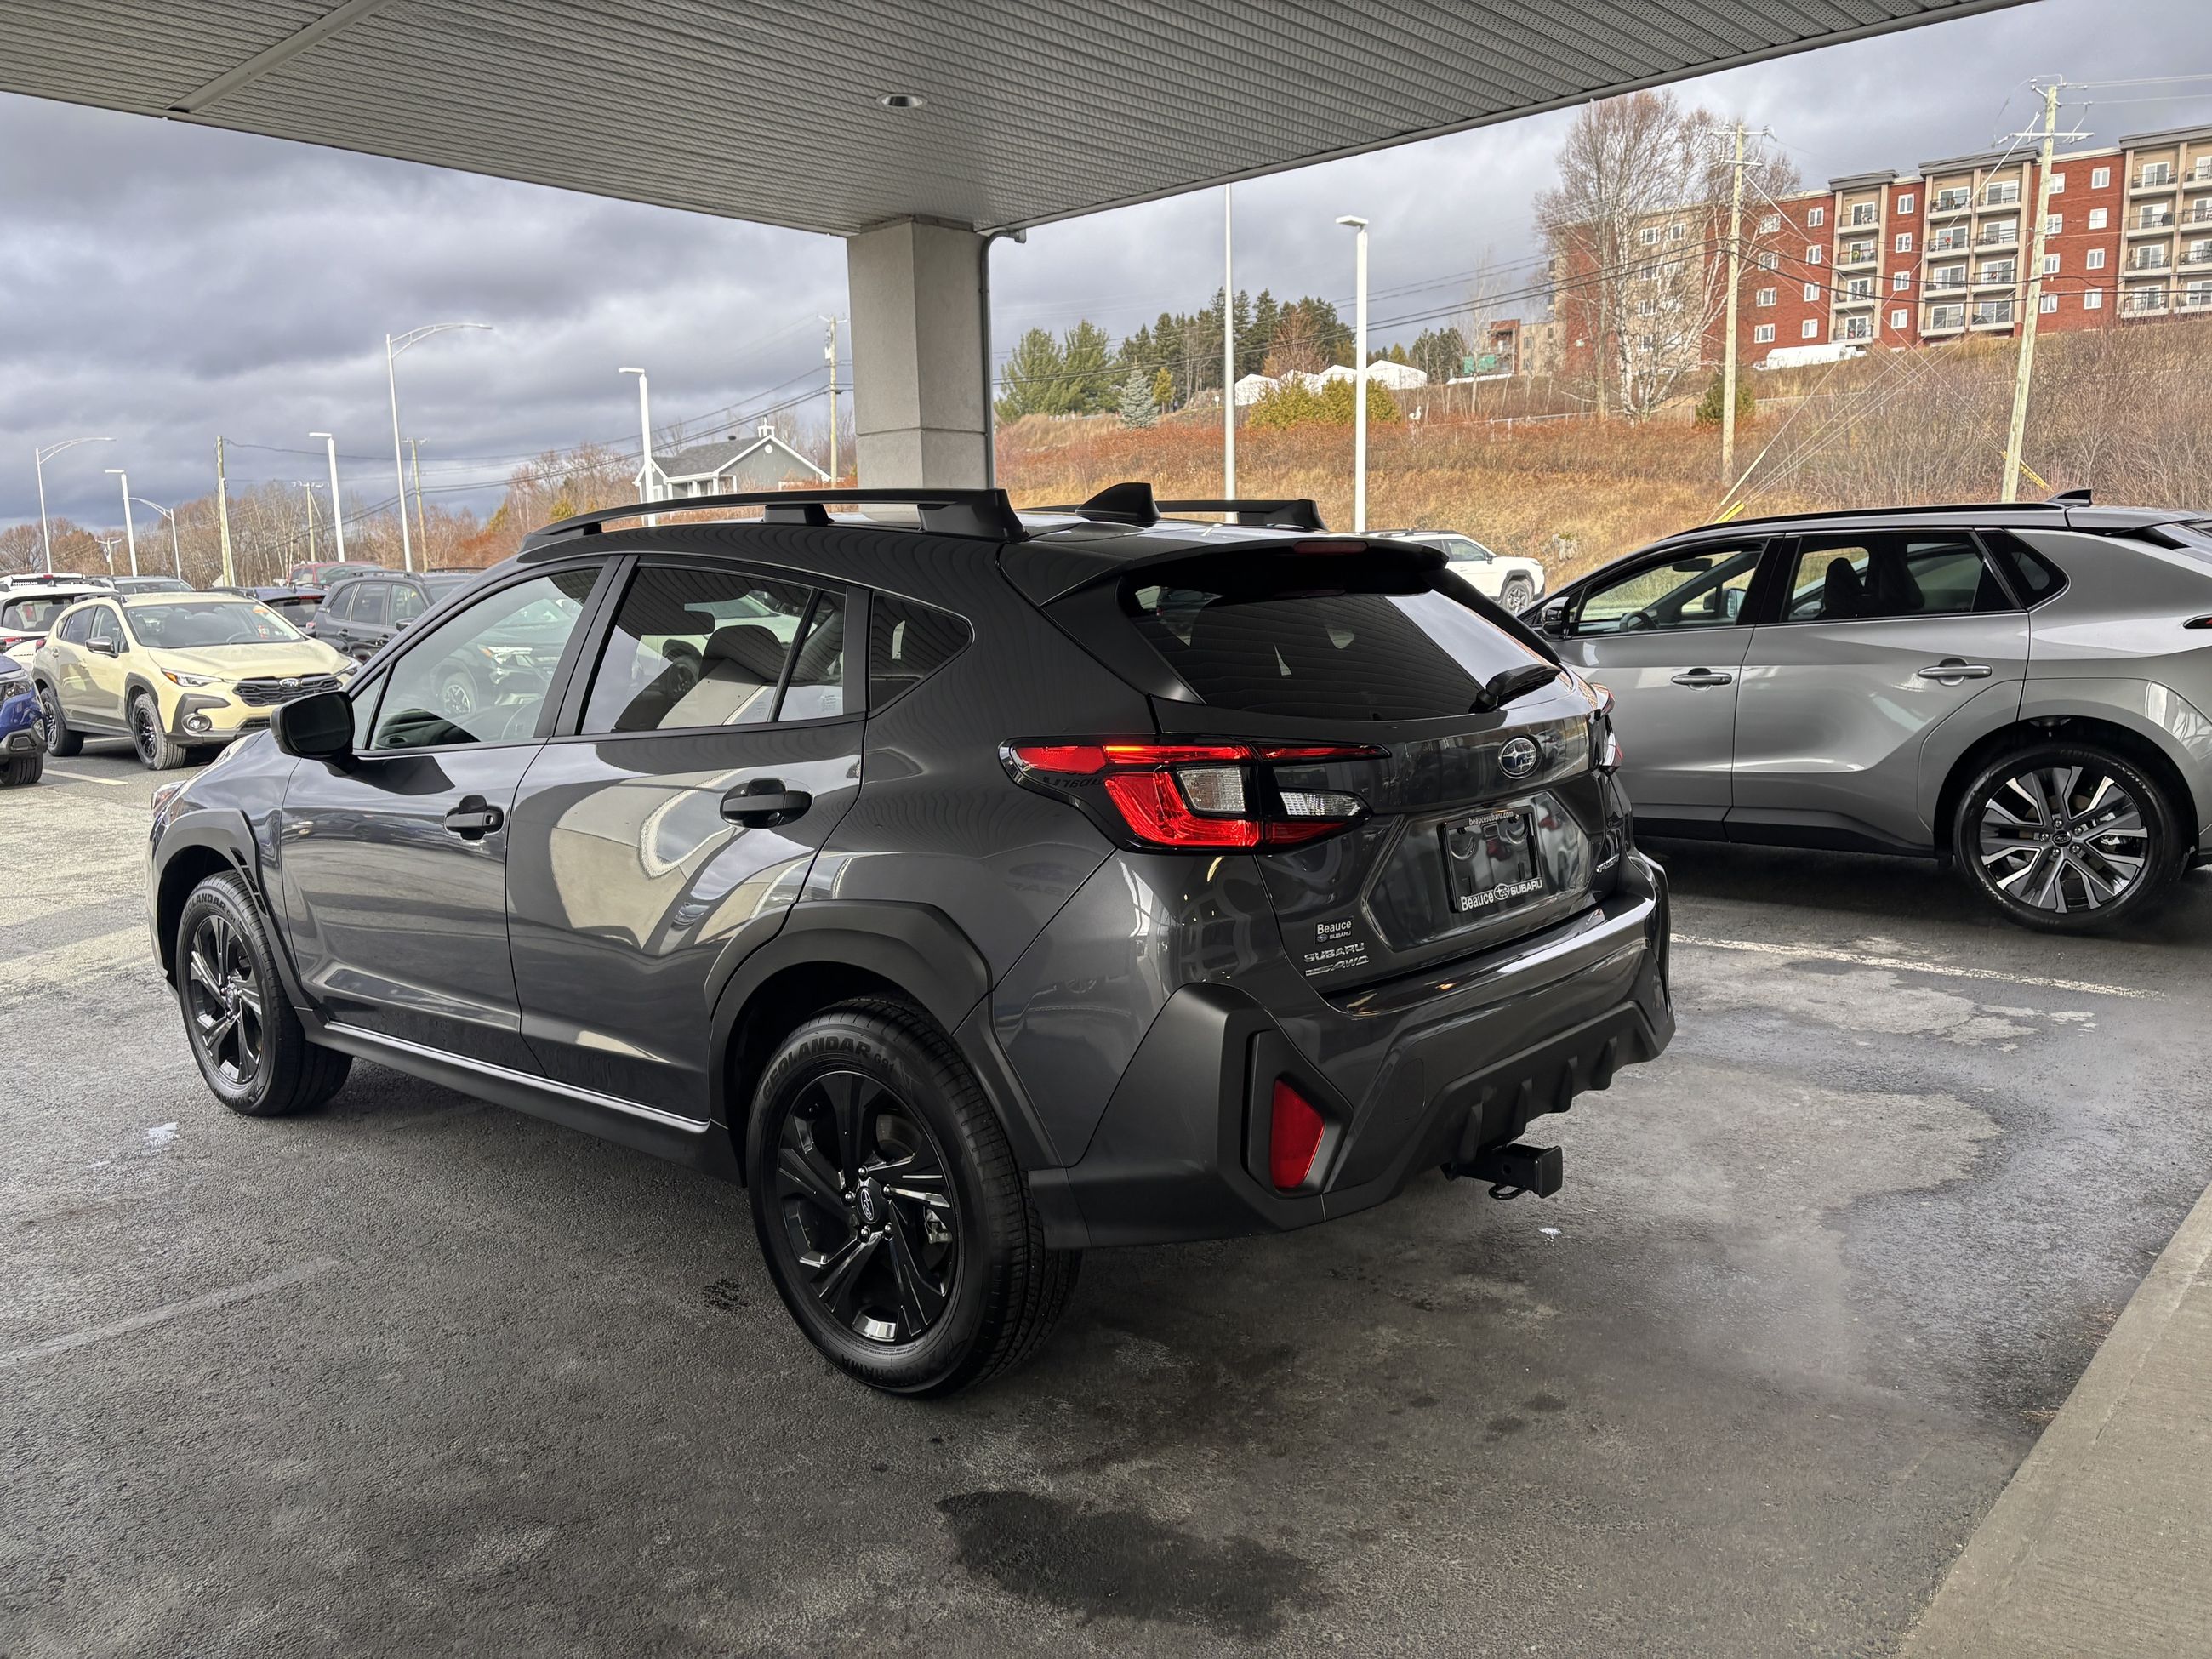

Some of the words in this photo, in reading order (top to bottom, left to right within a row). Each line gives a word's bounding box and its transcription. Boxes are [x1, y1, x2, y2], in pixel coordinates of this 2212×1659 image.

[1468, 811, 1514, 825] beaucesubaru.com
[1461, 892, 1494, 911] Beauce
[1510, 879, 1542, 896] SUBARU
[1317, 921, 1352, 935] Beauce
[1329, 931, 1351, 940] SUBARU
[1304, 942, 1365, 962] SUBARU
[1331, 955, 1370, 972] AWD
[762, 1036, 871, 1101] GEOLANDAR
